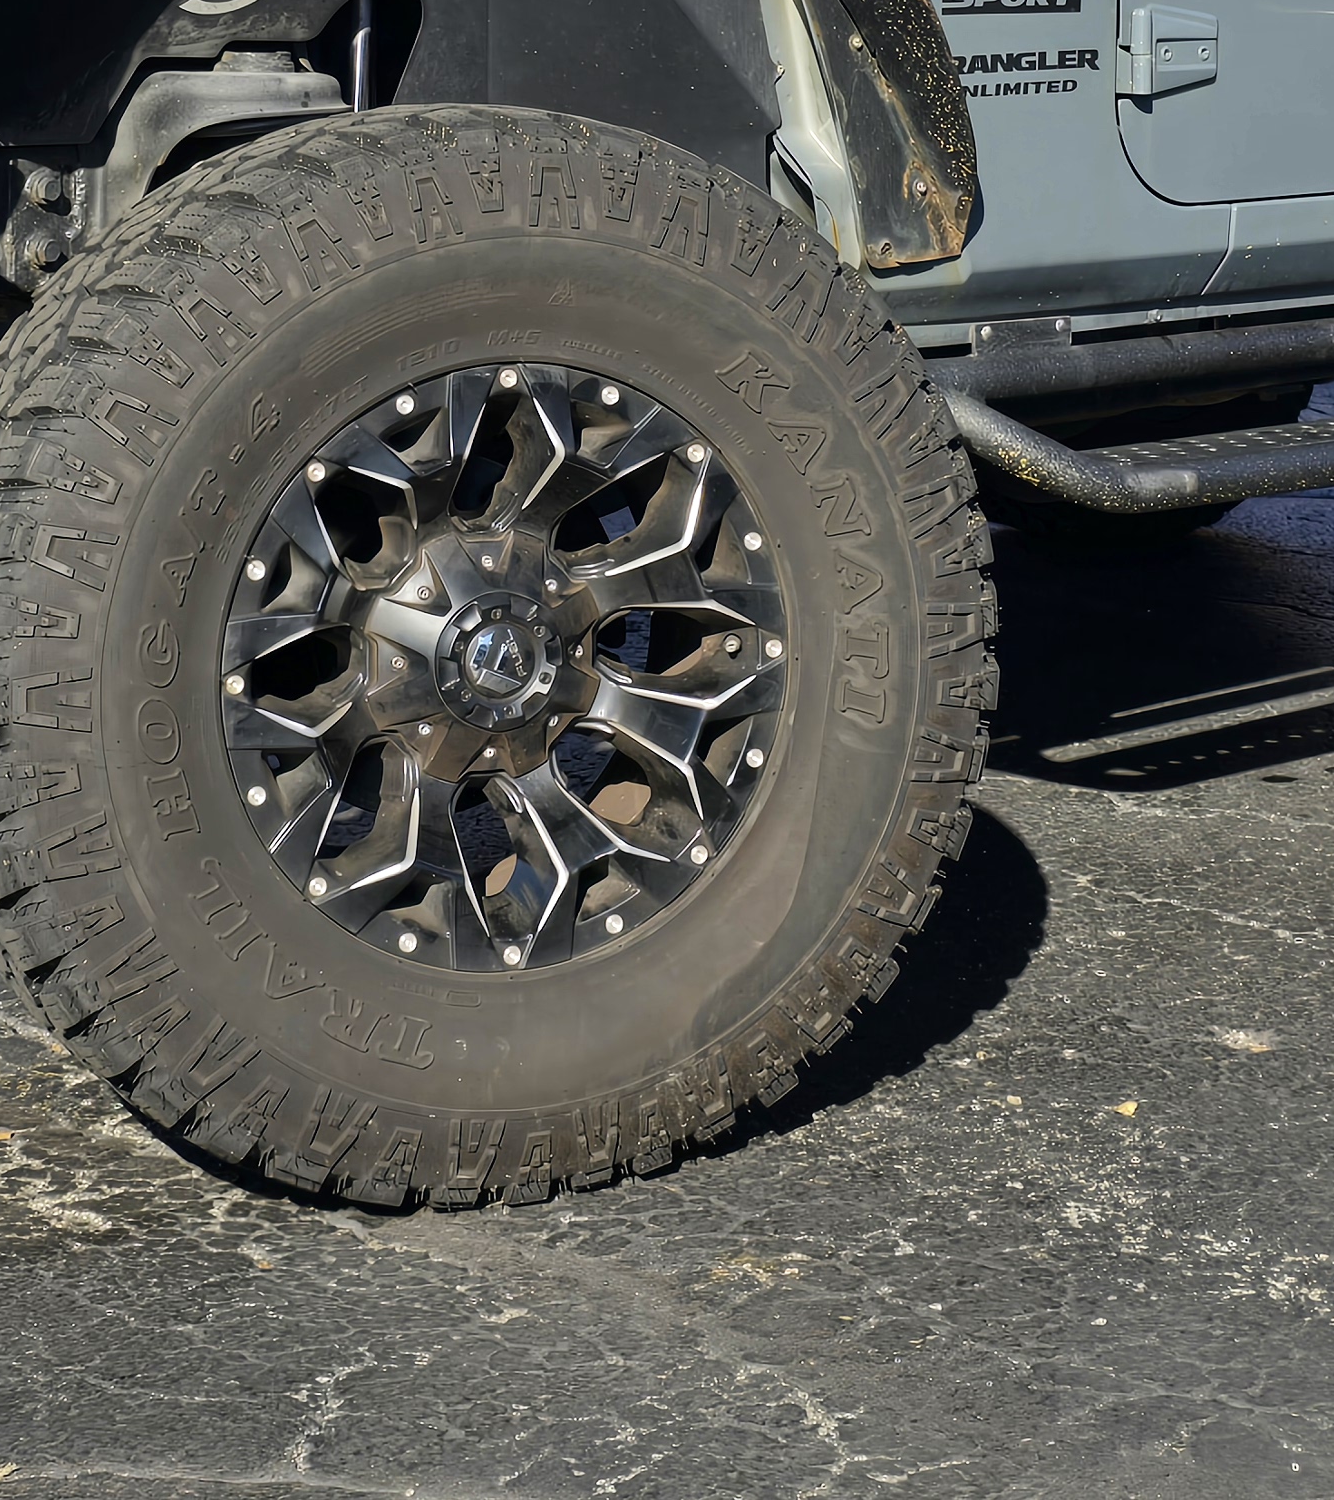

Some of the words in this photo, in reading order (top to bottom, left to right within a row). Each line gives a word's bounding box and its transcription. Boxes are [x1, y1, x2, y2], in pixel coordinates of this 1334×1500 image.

[953, 49, 1100, 75] RANGLER
[962, 79, 1078, 98] NLIMITED
[714, 350, 891, 724] KANATI
[137, 618, 201, 841] HOG
[187, 857, 435, 1071] TRAIL
